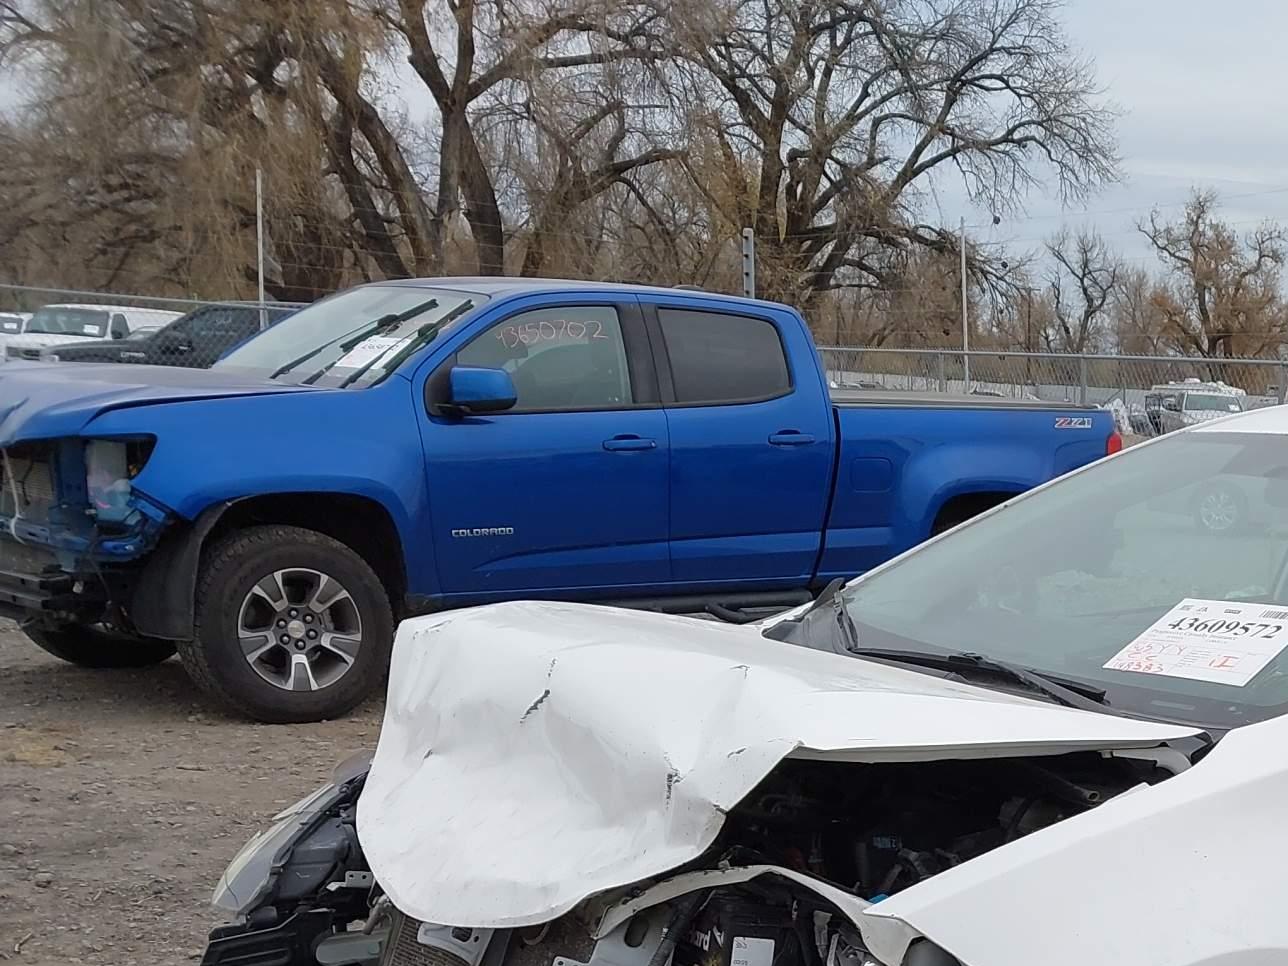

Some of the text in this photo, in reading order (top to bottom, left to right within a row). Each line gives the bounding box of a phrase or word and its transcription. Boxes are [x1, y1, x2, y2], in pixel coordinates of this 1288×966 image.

[496, 319, 609, 348] 43650702
[451, 526, 515, 538] COLORADO
[1167, 617, 1283, 639] 43609572
